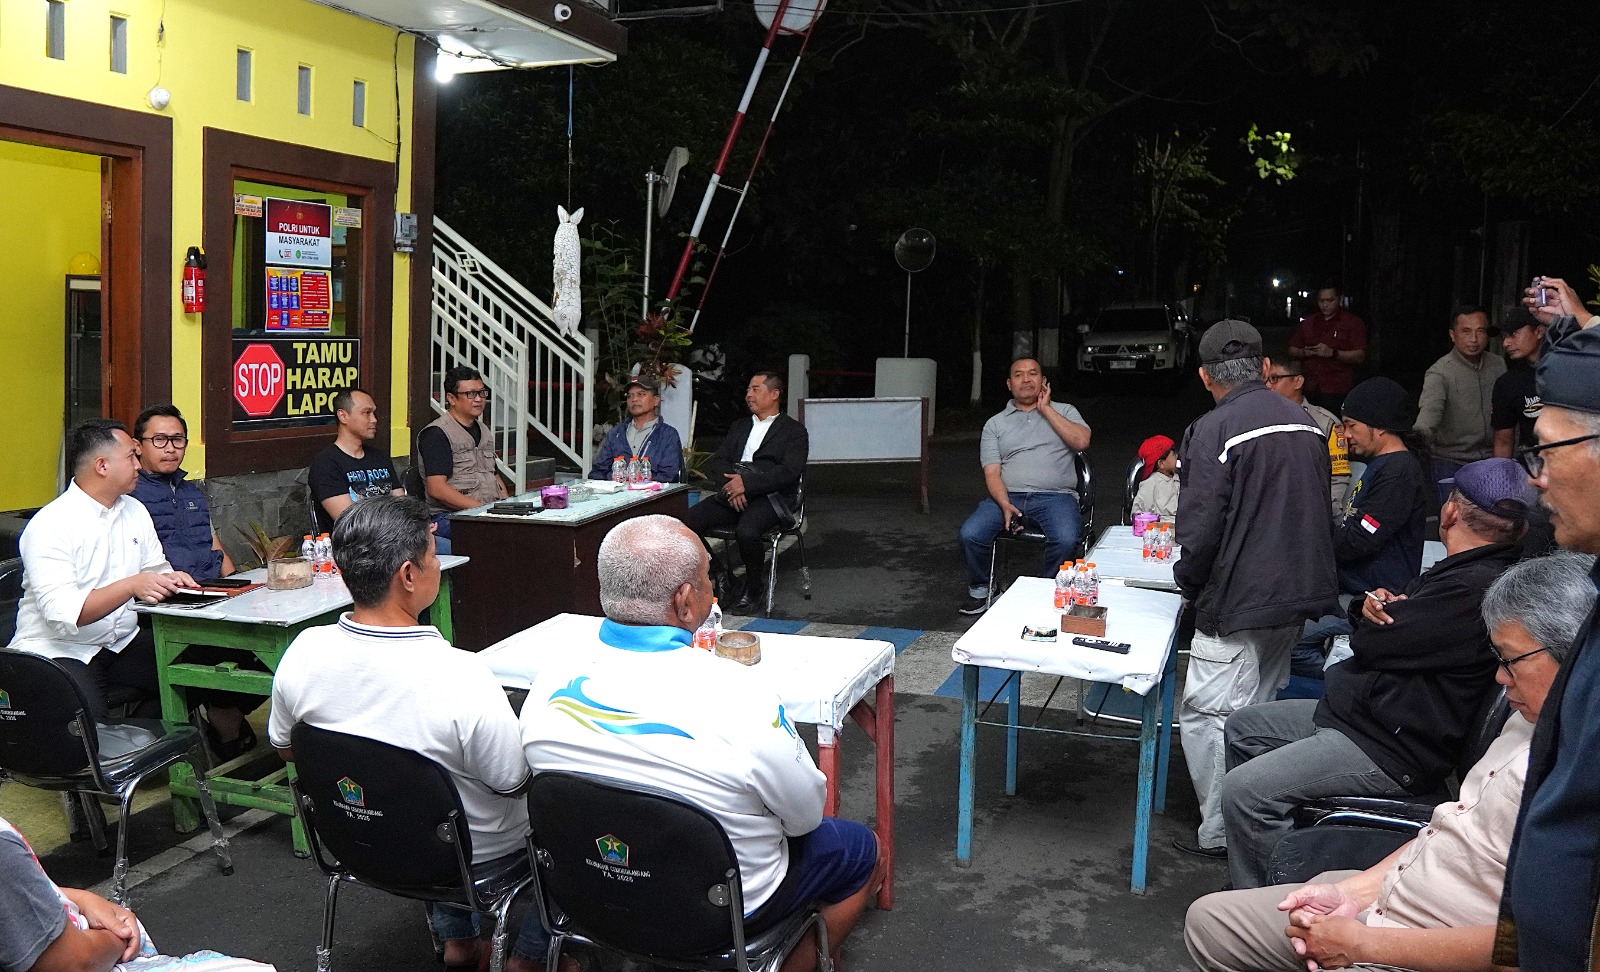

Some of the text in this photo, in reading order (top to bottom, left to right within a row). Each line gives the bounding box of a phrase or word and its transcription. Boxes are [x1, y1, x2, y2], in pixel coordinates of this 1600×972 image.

[278, 222, 320, 235] POLRI UNTUK
[278, 235, 320, 247] MASYARAKAT
[292, 342, 352, 364] TAMU
[237, 363, 282, 397] STOP
[286, 366, 358, 390] HARAP
[287, 391, 339, 416] LAPO
[366, 468, 391, 481] ROCK
